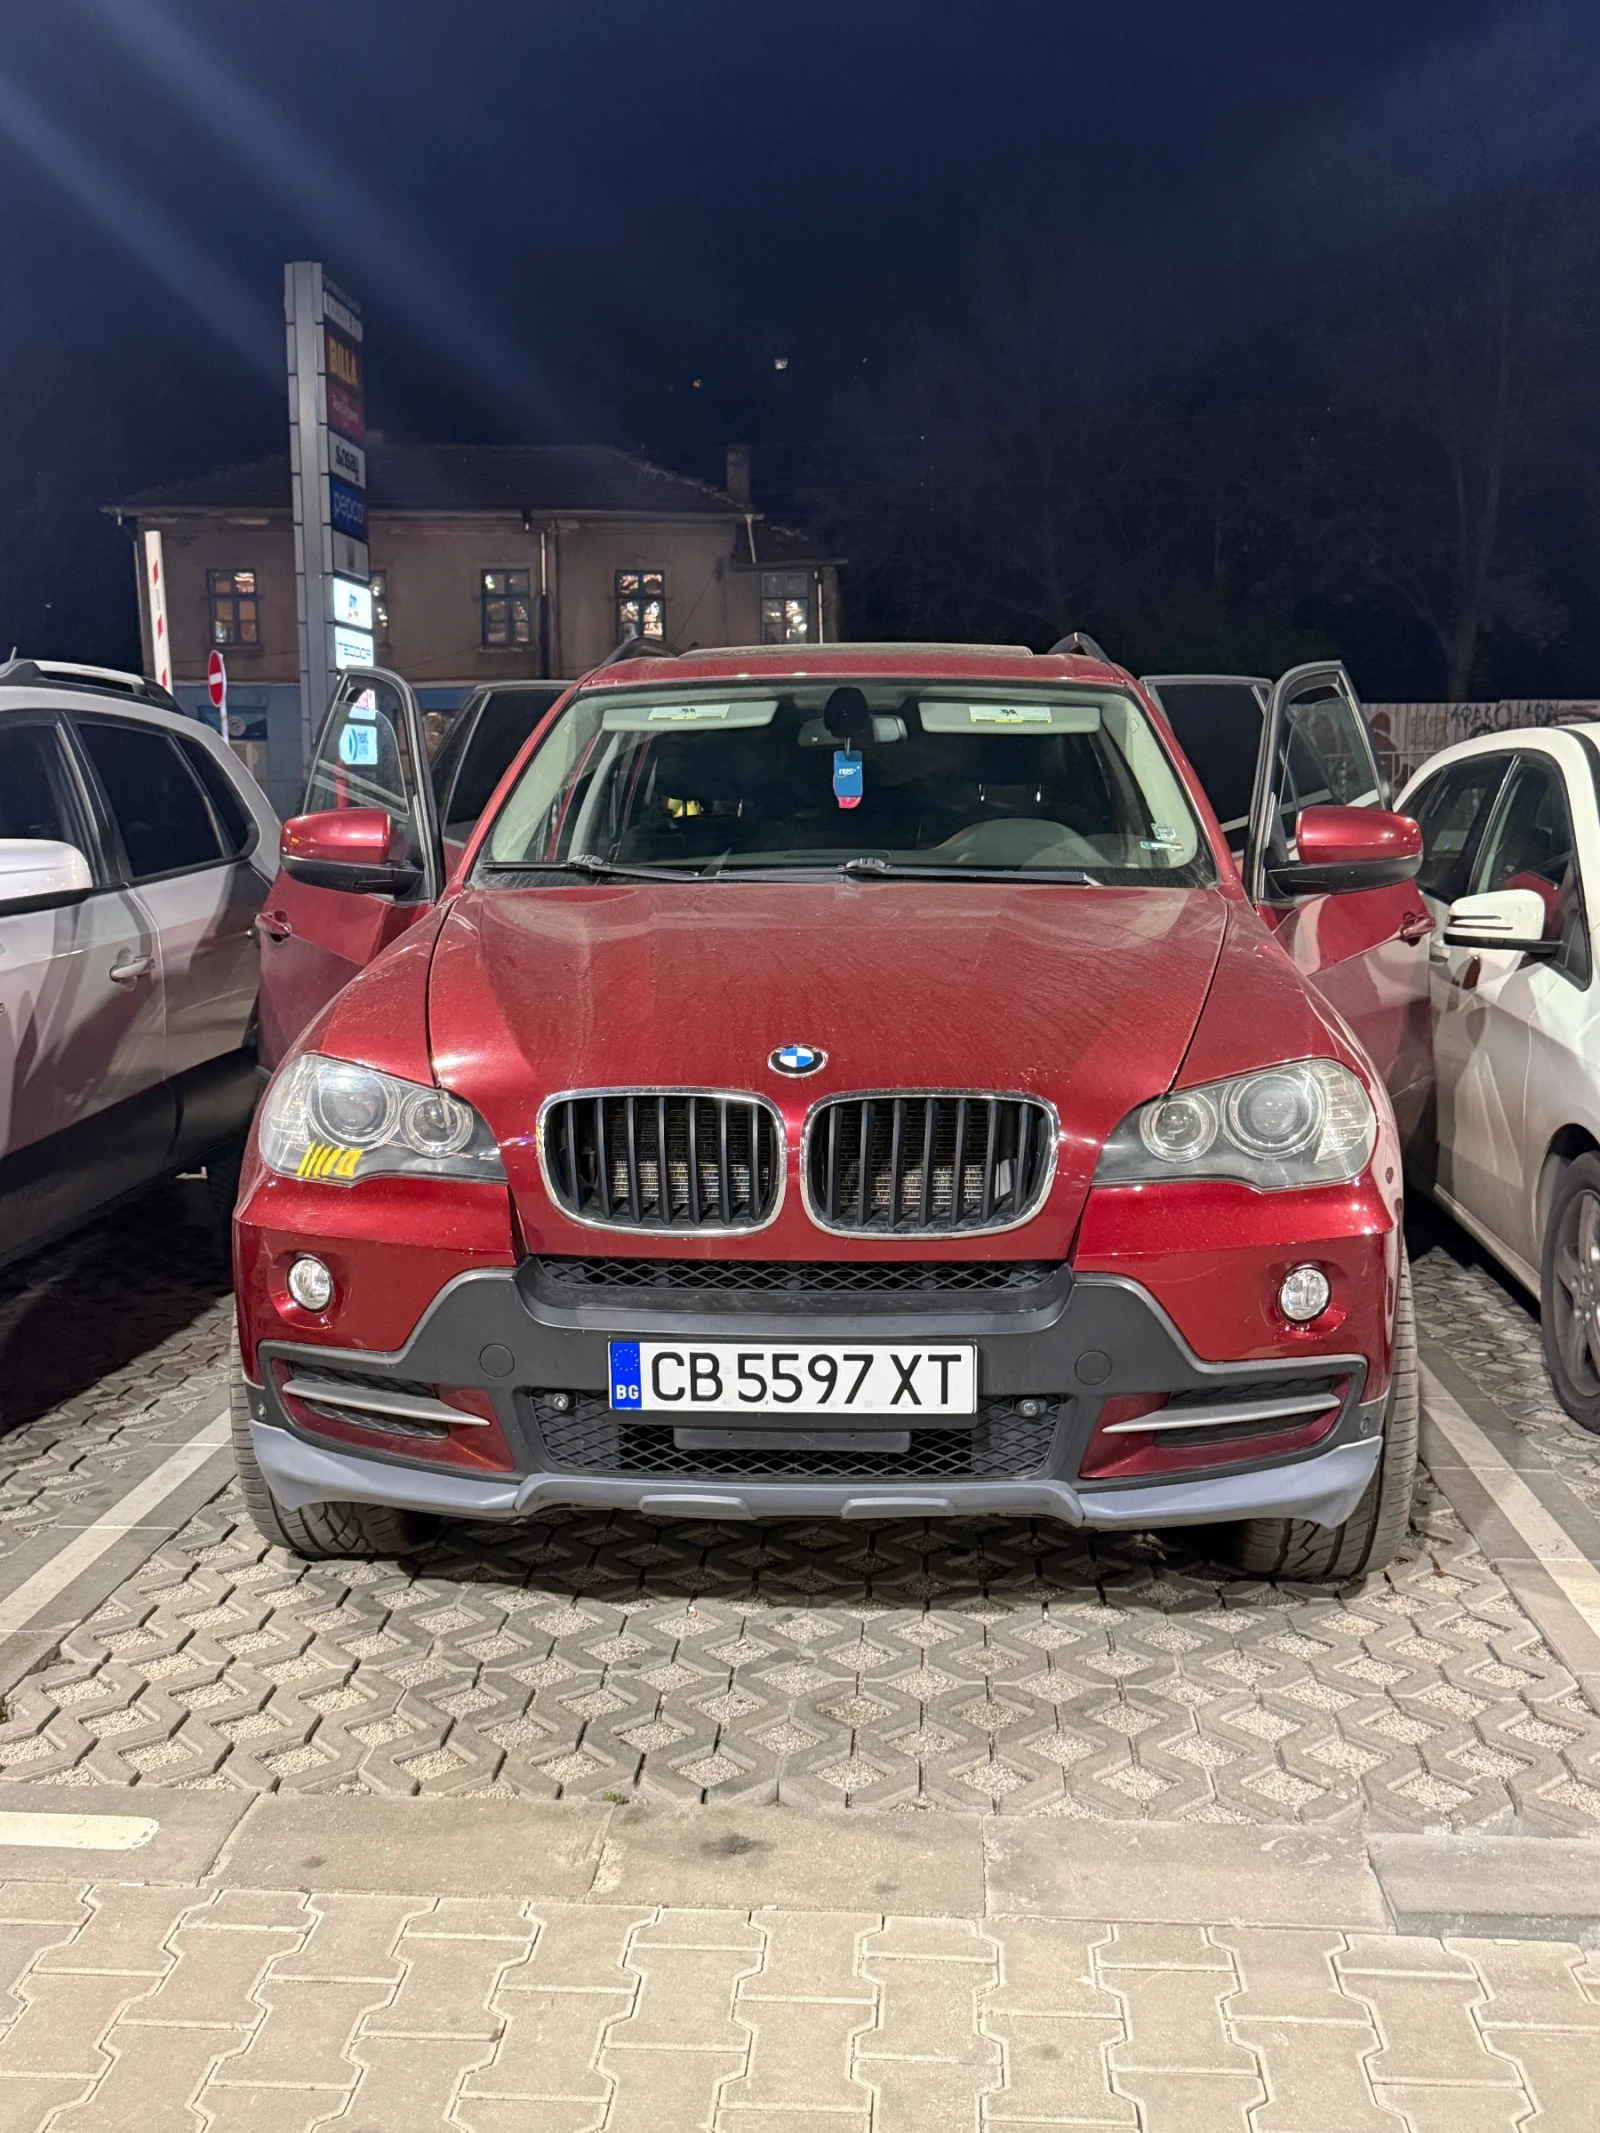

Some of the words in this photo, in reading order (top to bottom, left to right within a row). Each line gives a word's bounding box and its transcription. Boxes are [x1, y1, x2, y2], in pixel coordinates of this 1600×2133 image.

[333, 491, 364, 524] pepco
[616, 1384, 639, 1400] BG
[651, 1351, 722, 1402] CB
[737, 1353, 874, 1404] 5597
[890, 1354, 962, 1406] XT
